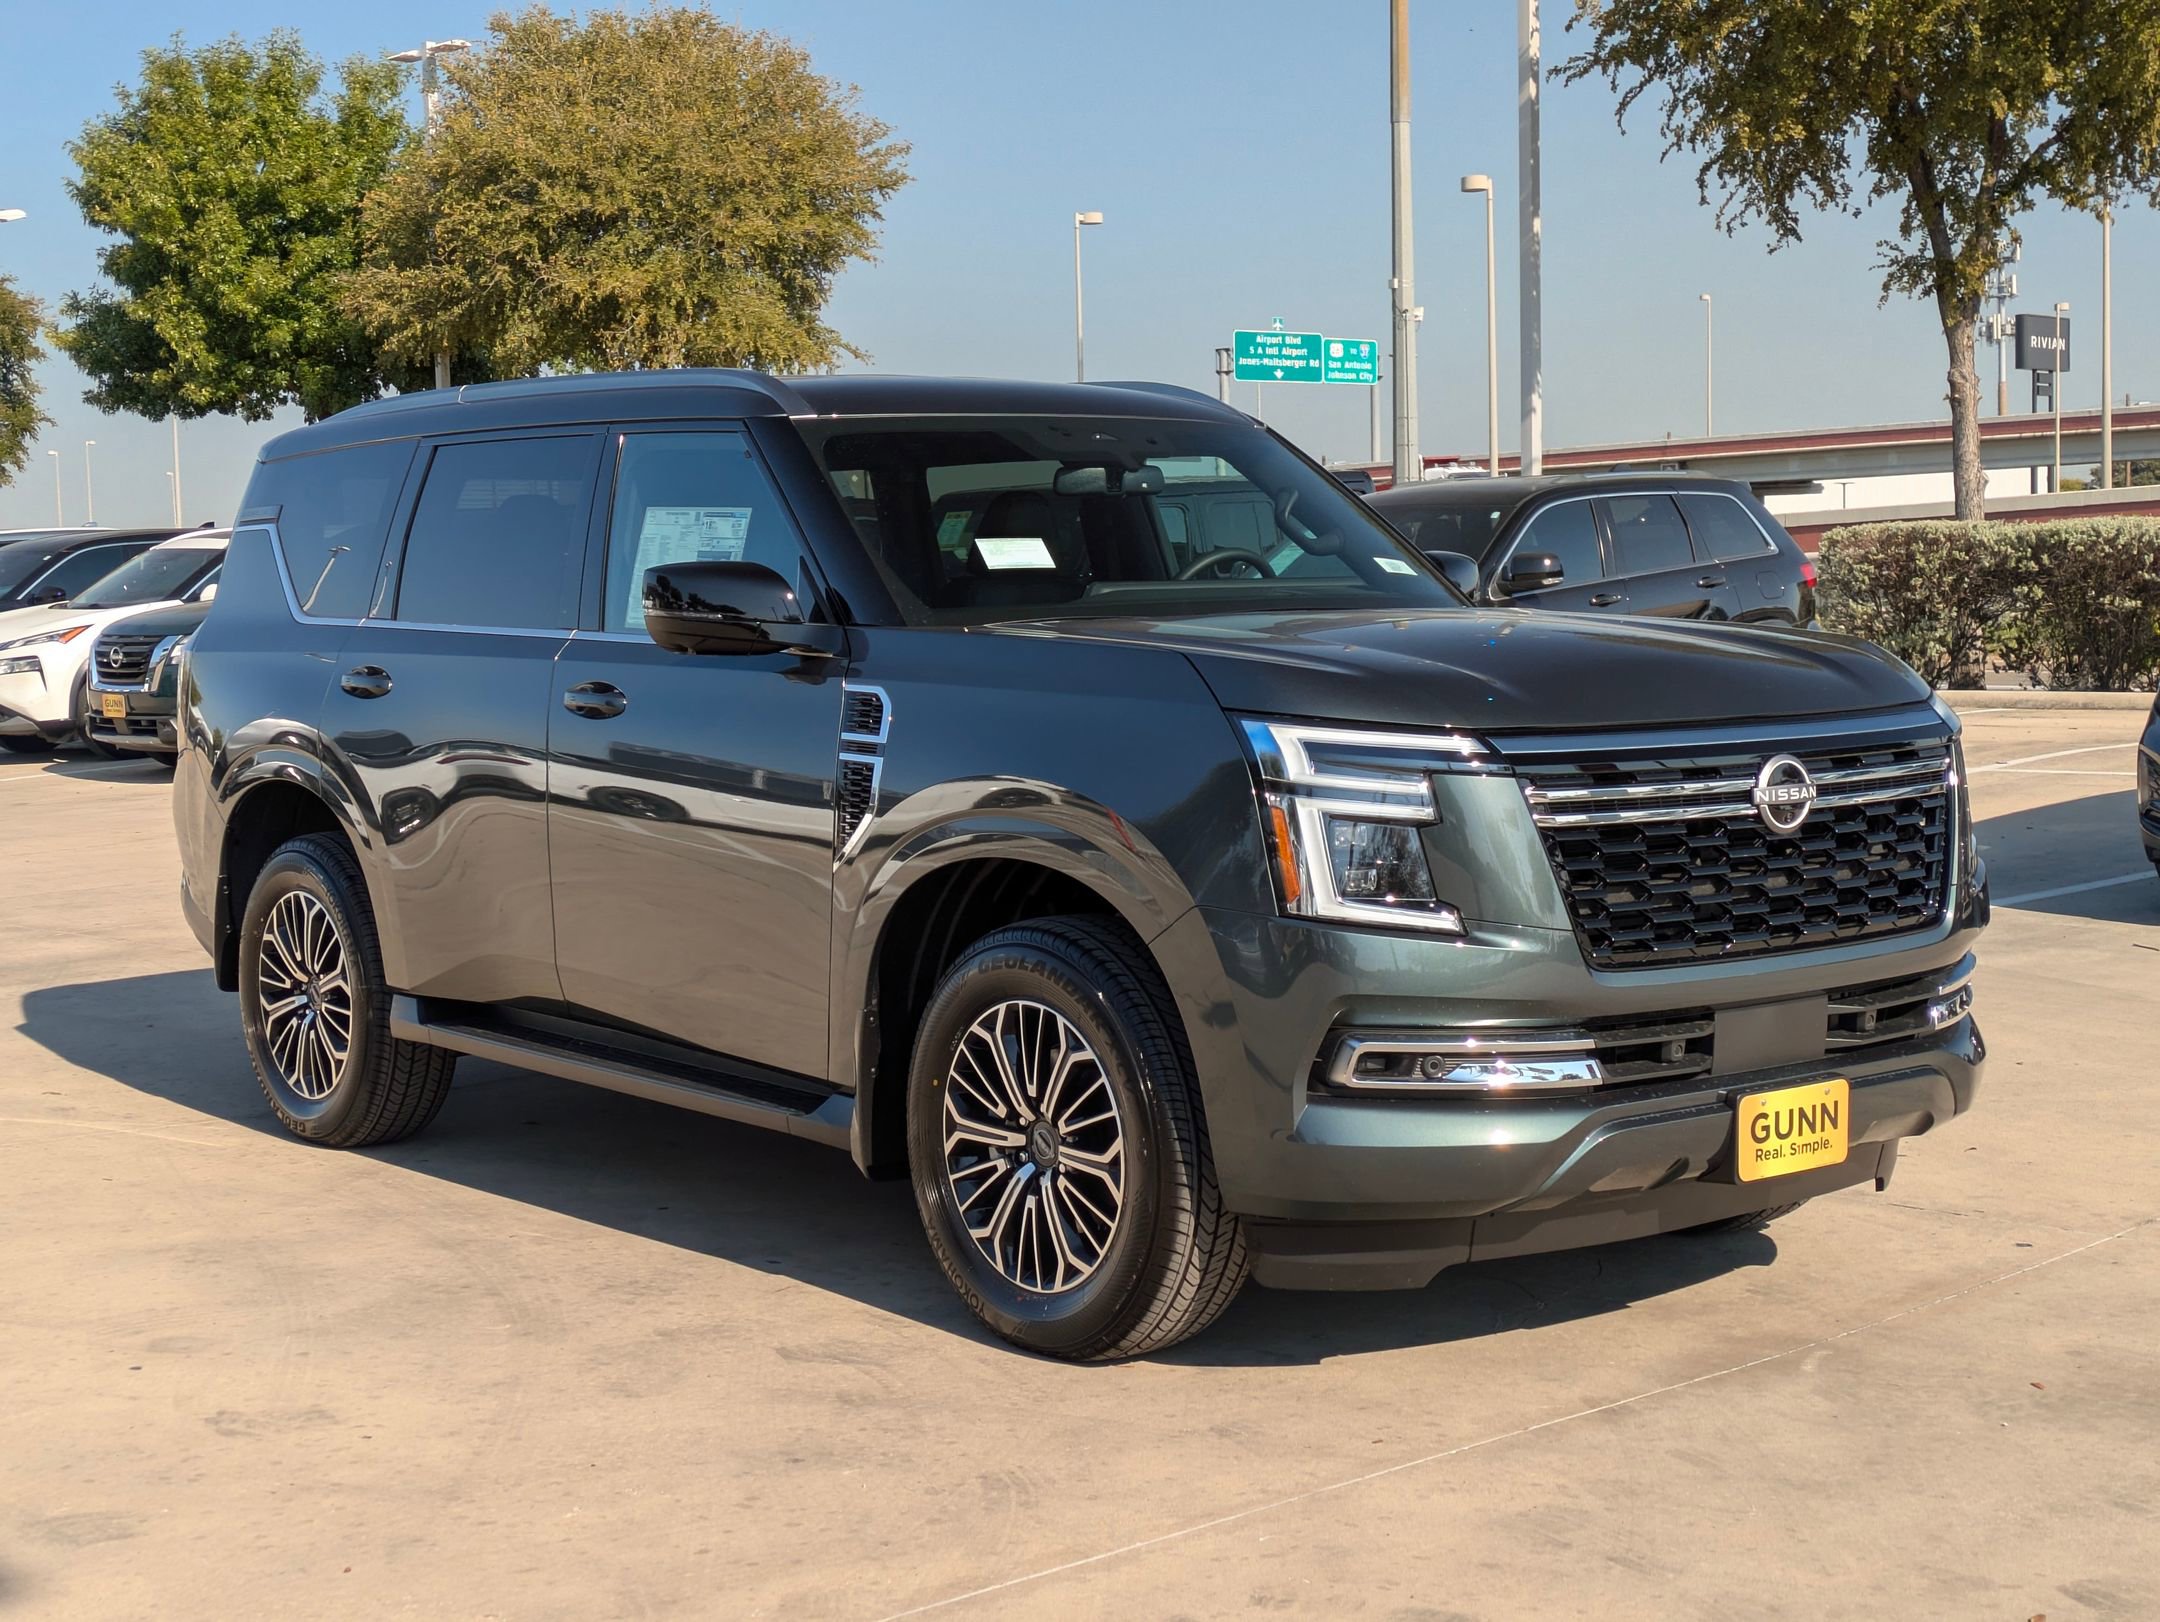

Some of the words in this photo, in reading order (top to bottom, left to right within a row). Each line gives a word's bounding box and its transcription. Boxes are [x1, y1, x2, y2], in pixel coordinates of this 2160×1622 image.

[1256, 335, 1282, 345] Airport
[1285, 336, 1302, 345] Blvd
[2031, 335, 2066, 351] RIVIAN
[1249, 346, 1255, 354] S
[1257, 346, 1263, 354] A
[1265, 346, 1279, 355] Intl
[1281, 347, 1308, 357] Airport
[1309, 359, 1320, 368] Rd
[1328, 360, 1342, 369] San
[1344, 361, 1372, 370] Antonio
[1328, 370, 1357, 380] Johnson
[1359, 371, 1373, 382] City
[105, 699, 123, 708] GUNN
[1756, 785, 1817, 803] NISSAN
[1750, 1100, 1839, 1144] GUNN
[1755, 1144, 1786, 1162] Real.
[1790, 1137, 1833, 1155] Simple.
